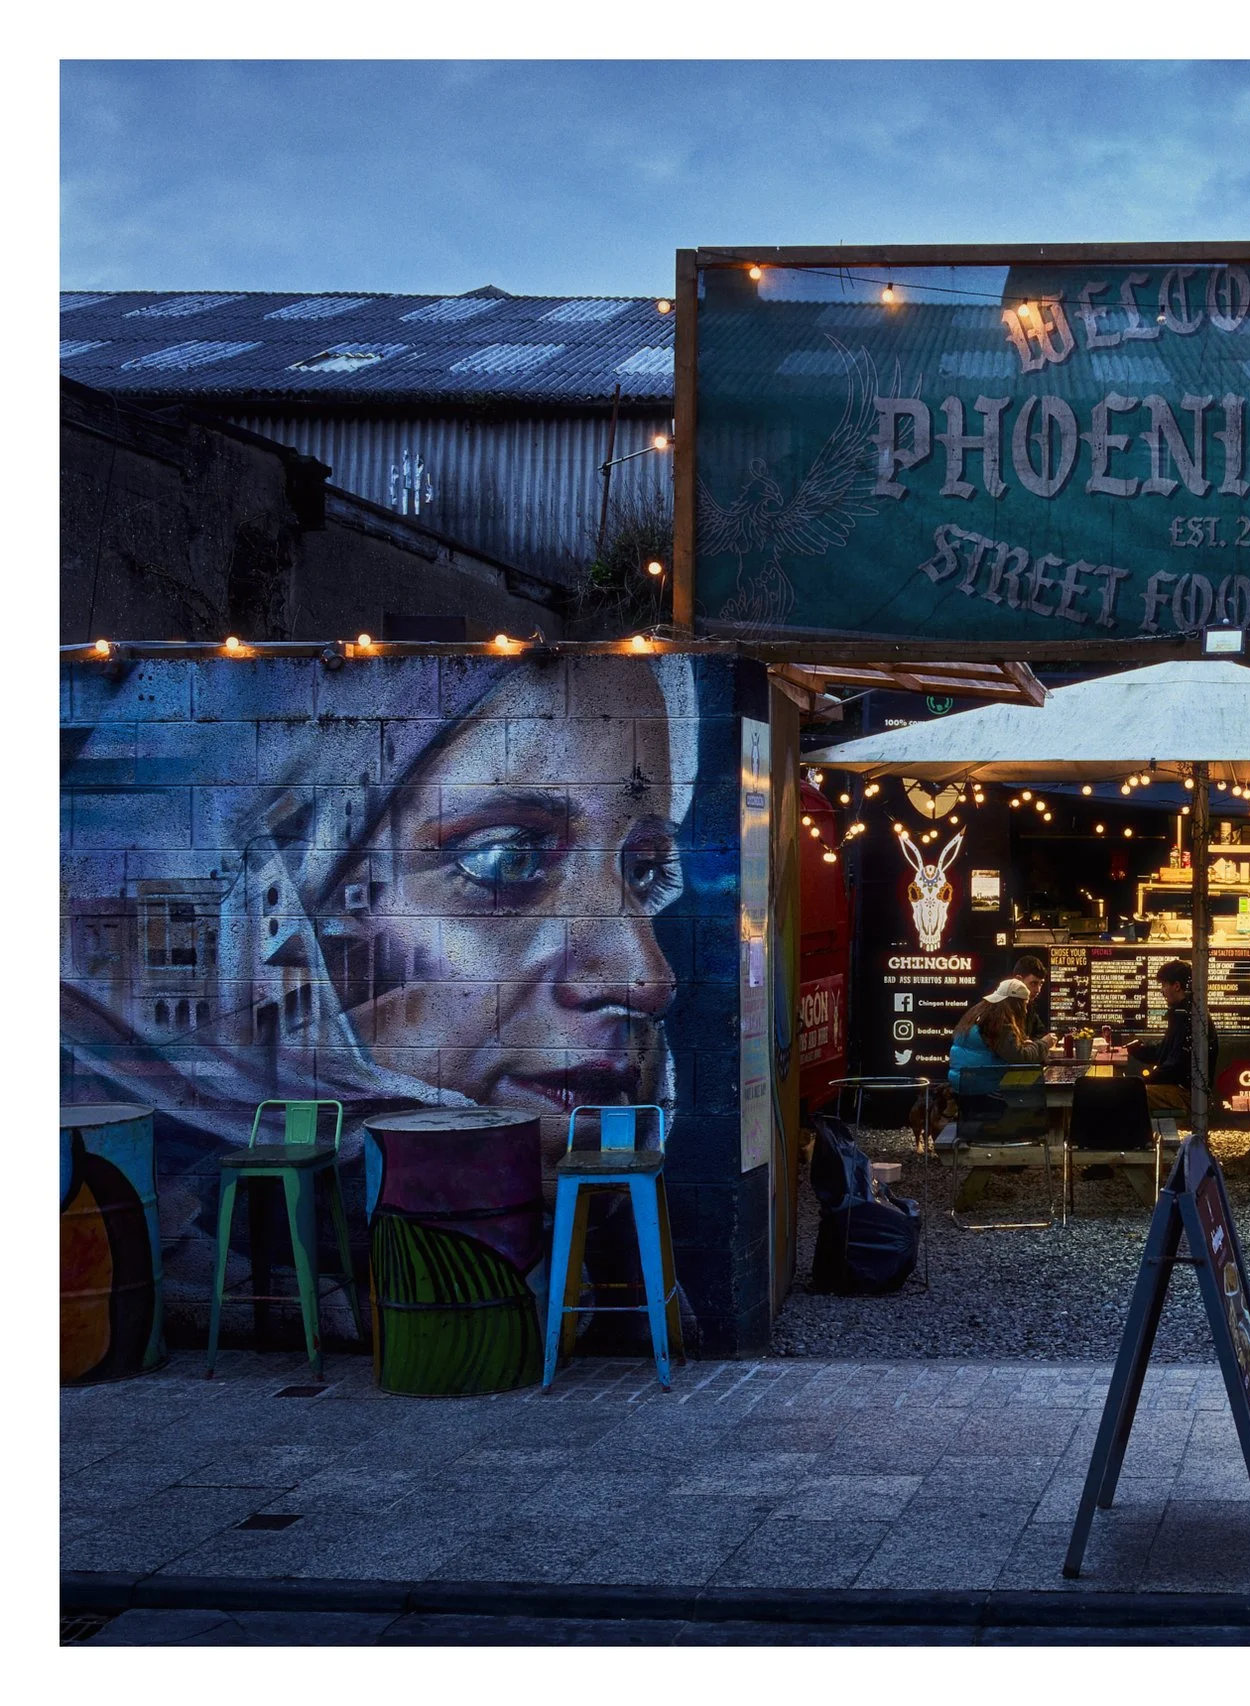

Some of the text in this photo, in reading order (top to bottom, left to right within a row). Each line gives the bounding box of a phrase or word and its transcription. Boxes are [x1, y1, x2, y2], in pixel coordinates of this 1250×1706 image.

[1169, 515, 1227, 549] EST.
[918, 523, 1129, 631] STREET
[884, 719, 908, 727] 100%
[884, 976, 976, 984] BAD ASS BURRITOS AND MORE
